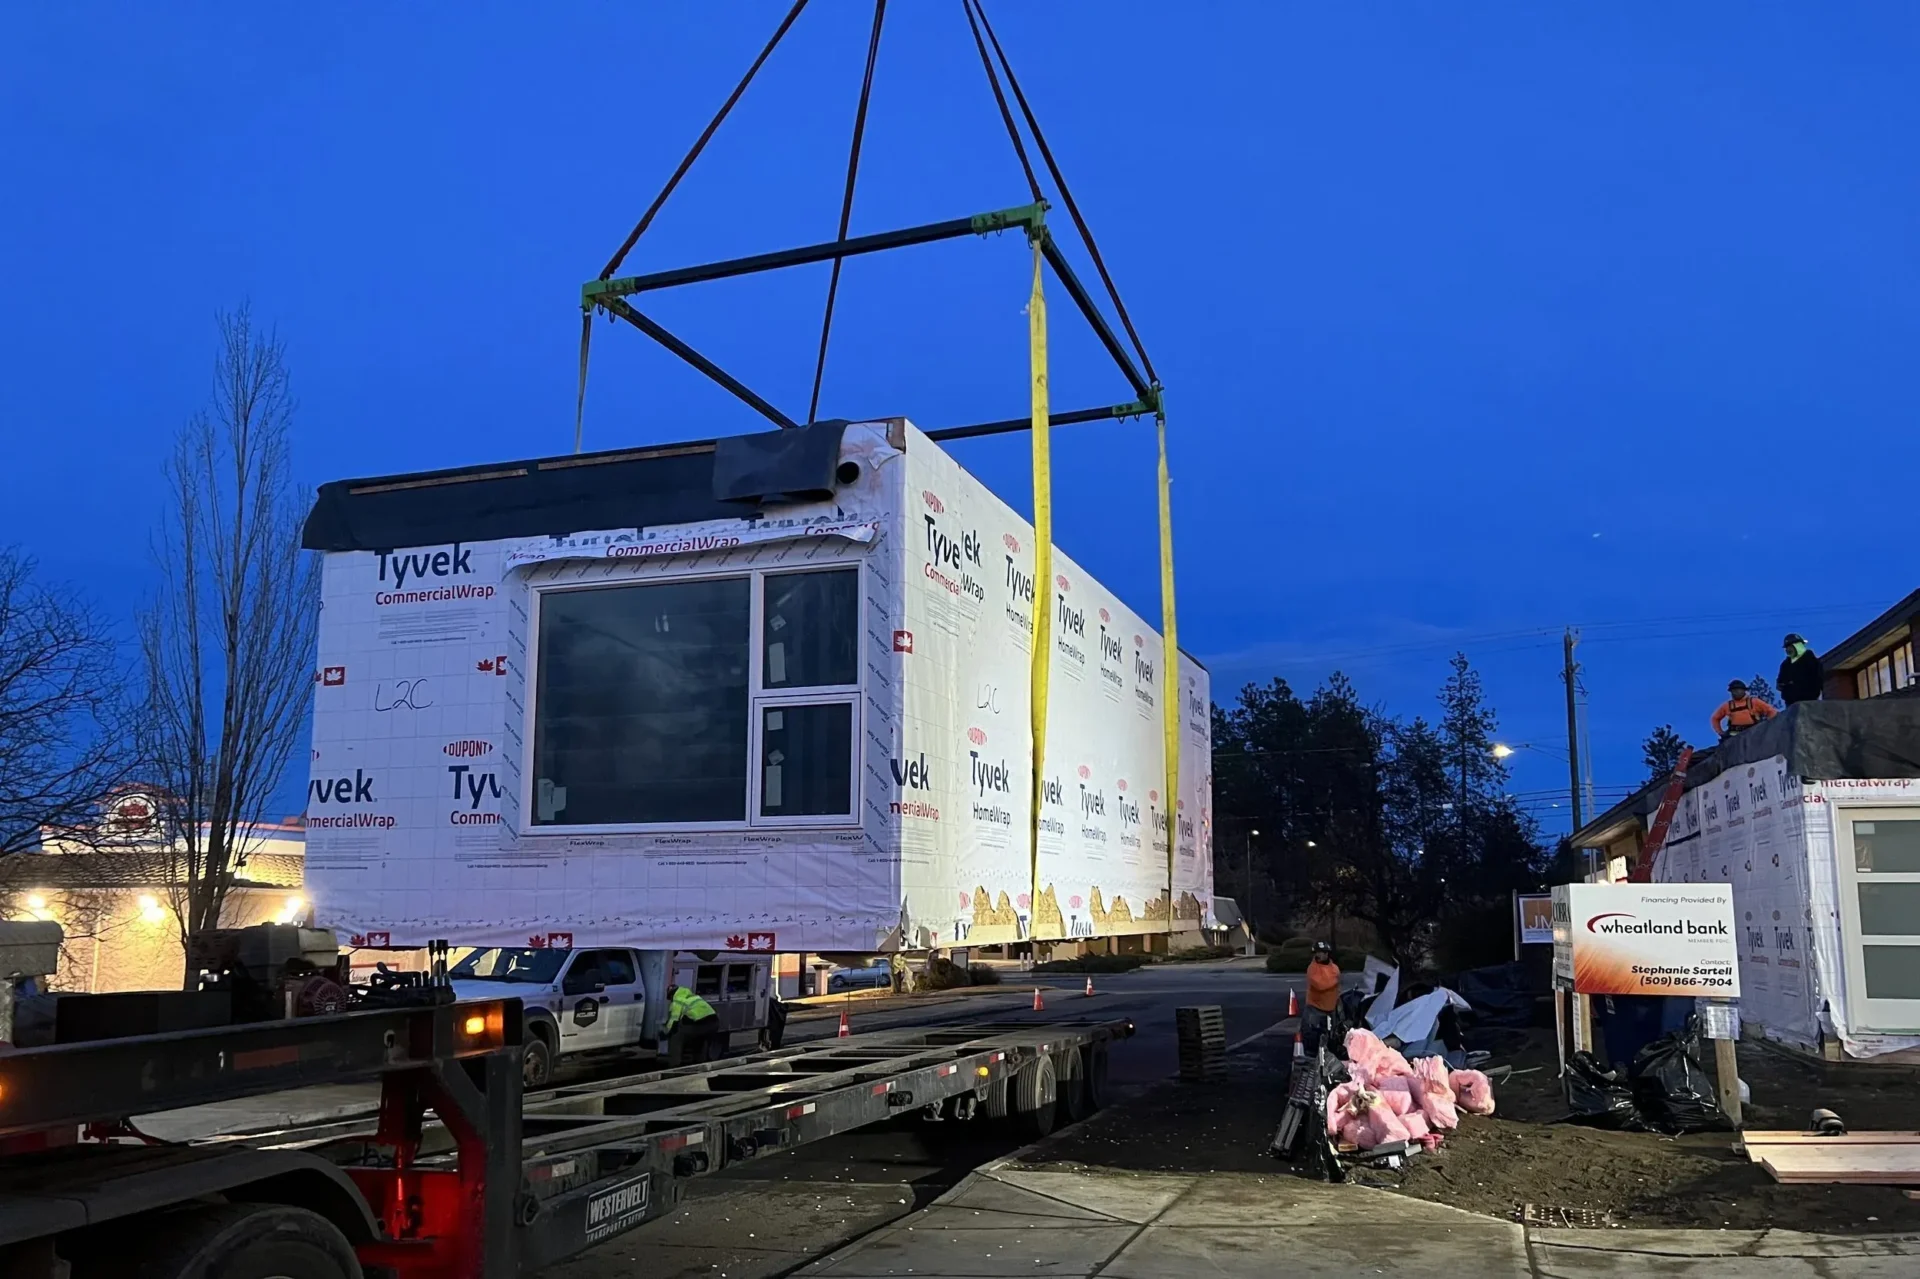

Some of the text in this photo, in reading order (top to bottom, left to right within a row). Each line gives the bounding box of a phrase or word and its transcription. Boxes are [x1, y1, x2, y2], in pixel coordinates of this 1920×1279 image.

[374, 543, 473, 589] Tyvek
[376, 584, 494, 605] CommercialWrap
[1006, 604, 1034, 635] HomeWra
[1058, 593, 1085, 638] Tyvek
[1058, 636, 1086, 666] HomeWrap
[1100, 625, 1122, 664] Tyvek
[1135, 650, 1154, 685] Tyvek
[375, 679, 433, 711] L2C
[977, 683, 1001, 714] L2C
[449, 740, 488, 757] DUPONT
[970, 751, 1009, 797] Tyvek
[973, 802, 1011, 829] HomeWrap
[1080, 784, 1106, 820] Tyvek
[1119, 796, 1140, 828] Tyvek
[451, 811, 501, 825] Comm
[1038, 817, 1065, 836] omeWrap
[1178, 813, 1194, 838] Tyvek
[1081, 824, 1107, 845] HomeWrap
[1641, 896, 1727, 905] Financing Provided By
[1600, 919, 1728, 935] wheatland bank
[1631, 965, 1732, 976] Stephanie Sartell
[1640, 976, 1733, 987] (509) 866-7904
[590, 1180, 648, 1225] WESTERVELT
[586, 1220, 622, 1243] TRANSPORT
[628, 1210, 646, 1225] SETUP
